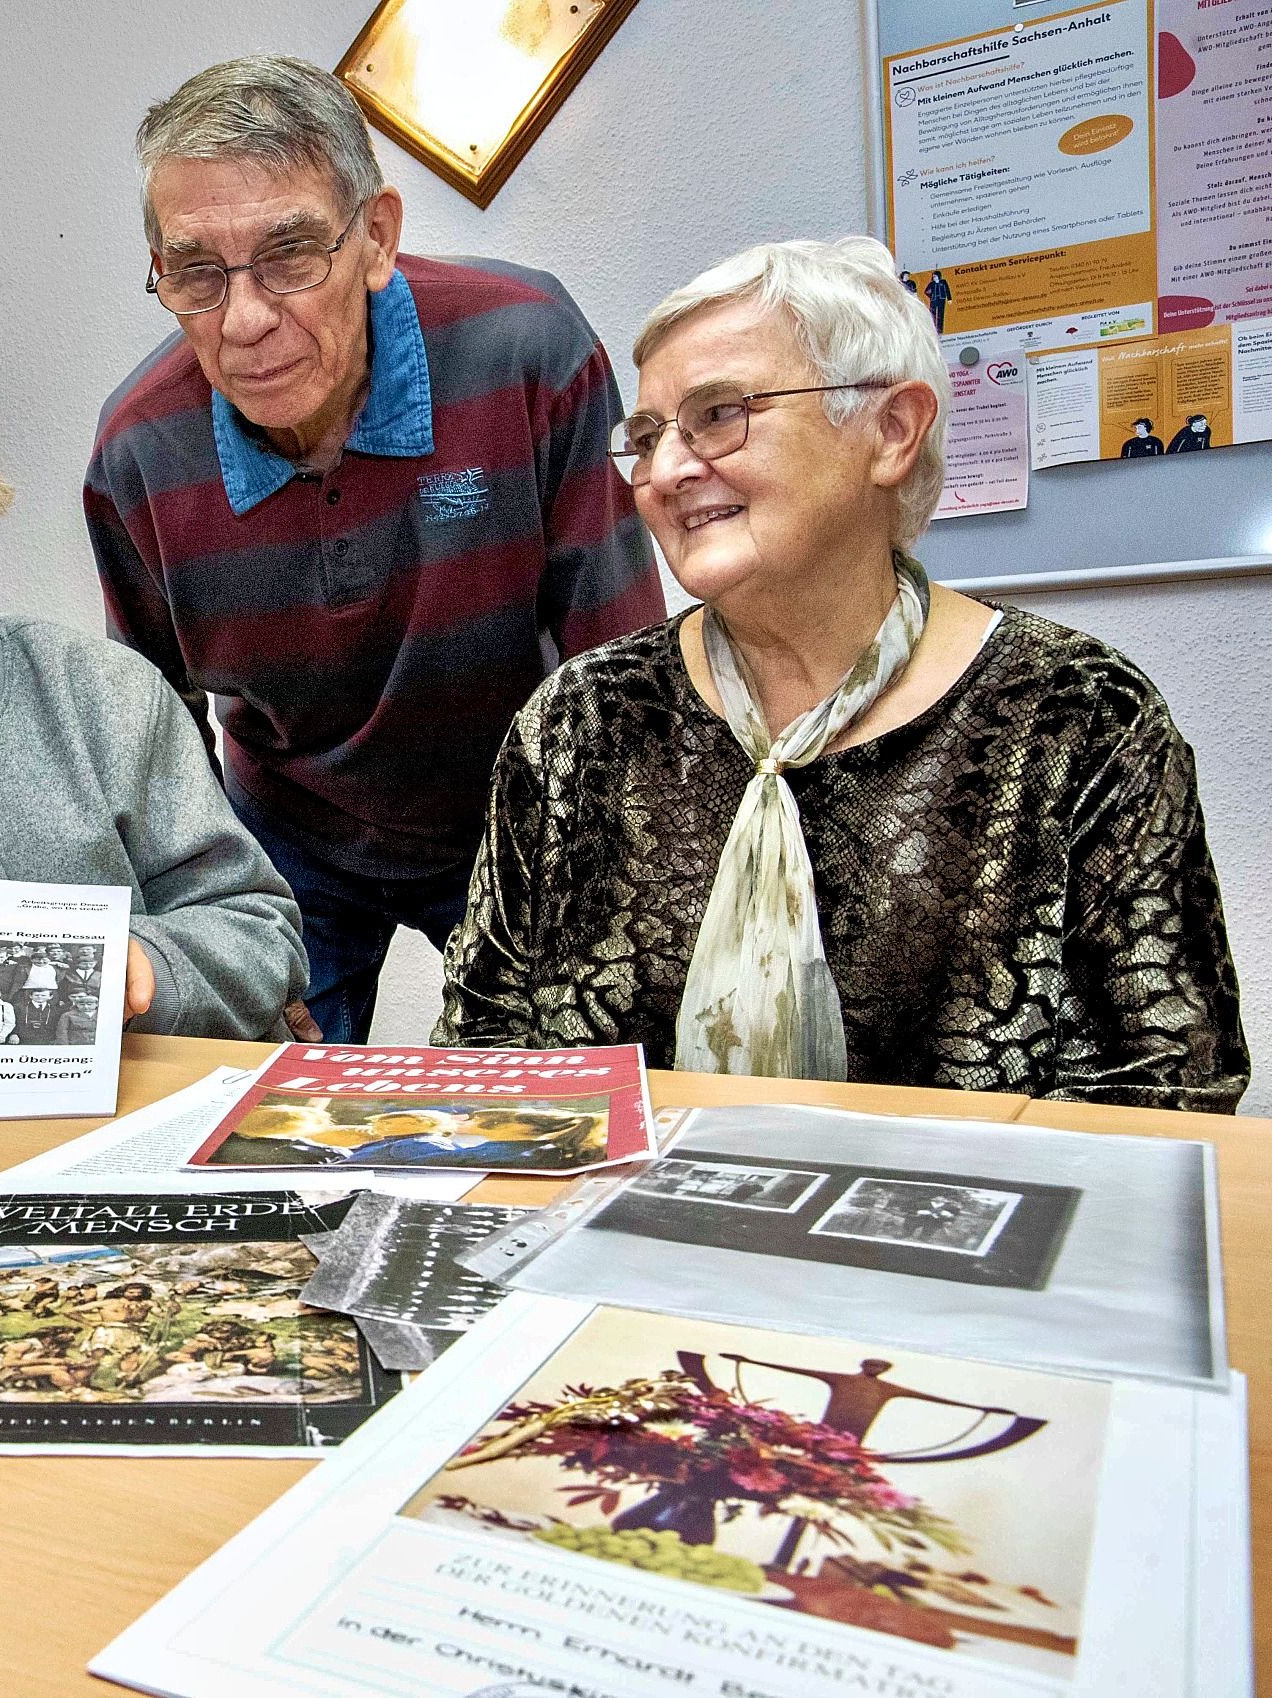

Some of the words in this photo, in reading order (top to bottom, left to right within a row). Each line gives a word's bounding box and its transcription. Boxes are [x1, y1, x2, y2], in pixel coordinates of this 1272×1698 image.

[1235, 11, 1255, 22] Erhalt
[1256, 9, 1269, 17] von
[1197, 28, 1237, 42] Unterstütze
[1197, 32, 1264, 53] AWO-Mitgliedschaft
[892, 40, 1008, 76] Nachbarschaftshilfe
[1012, 13, 1111, 46] Sachsen-Anhalt
[917, 98, 931, 106] Mit
[932, 90, 965, 102] kleinem
[967, 80, 1005, 94] Aufwand
[1008, 70, 1051, 85] Menschen
[1053, 60, 1093, 76] glücklich
[1095, 50, 1134, 64] machen.
[1211, 82, 1233, 92] alleine
[1215, 94, 1235, 103] einem
[1237, 87, 1263, 98] starken
[1203, 146, 1235, 157] Menschen
[1244, 140, 1265, 149] deiner
[1206, 138, 1220, 146] dich
[1215, 153, 1255, 166] Erfahrungen
[1256, 149, 1269, 158] und
[920, 177, 958, 190] Mögliche
[959, 167, 1010, 181] Tätigkeiten:
[1168, 198, 1190, 208] Soziale
[1191, 194, 1216, 203] Themen
[1239, 186, 1253, 195] dich
[1183, 202, 1226, 216] AWO-Mitglied
[1227, 200, 1241, 208] bist
[1193, 212, 1236, 225] international
[954, 263, 988, 276] Kontakt
[989, 261, 1007, 270] zum
[1008, 250, 1067, 267] Servicepunkt:
[1203, 257, 1227, 267] Stimme
[1228, 253, 1247, 263] einem
[956, 370, 969, 378] YOGA
[995, 367, 1018, 379] AWO
[16, 931, 58, 939] Region
[18, 1054, 94, 1065] Übergang:
[297, 1046, 427, 1065] Vom
[435, 1048, 587, 1065] Sinn
[340, 1063, 612, 1080] unseres
[272, 1076, 527, 1095] Lebens
[182, 1202, 306, 1218] ERDE
[29, 1217, 238, 1235] MENSCH
[336, 1616, 362, 1633] in
[369, 1625, 423, 1646] der
